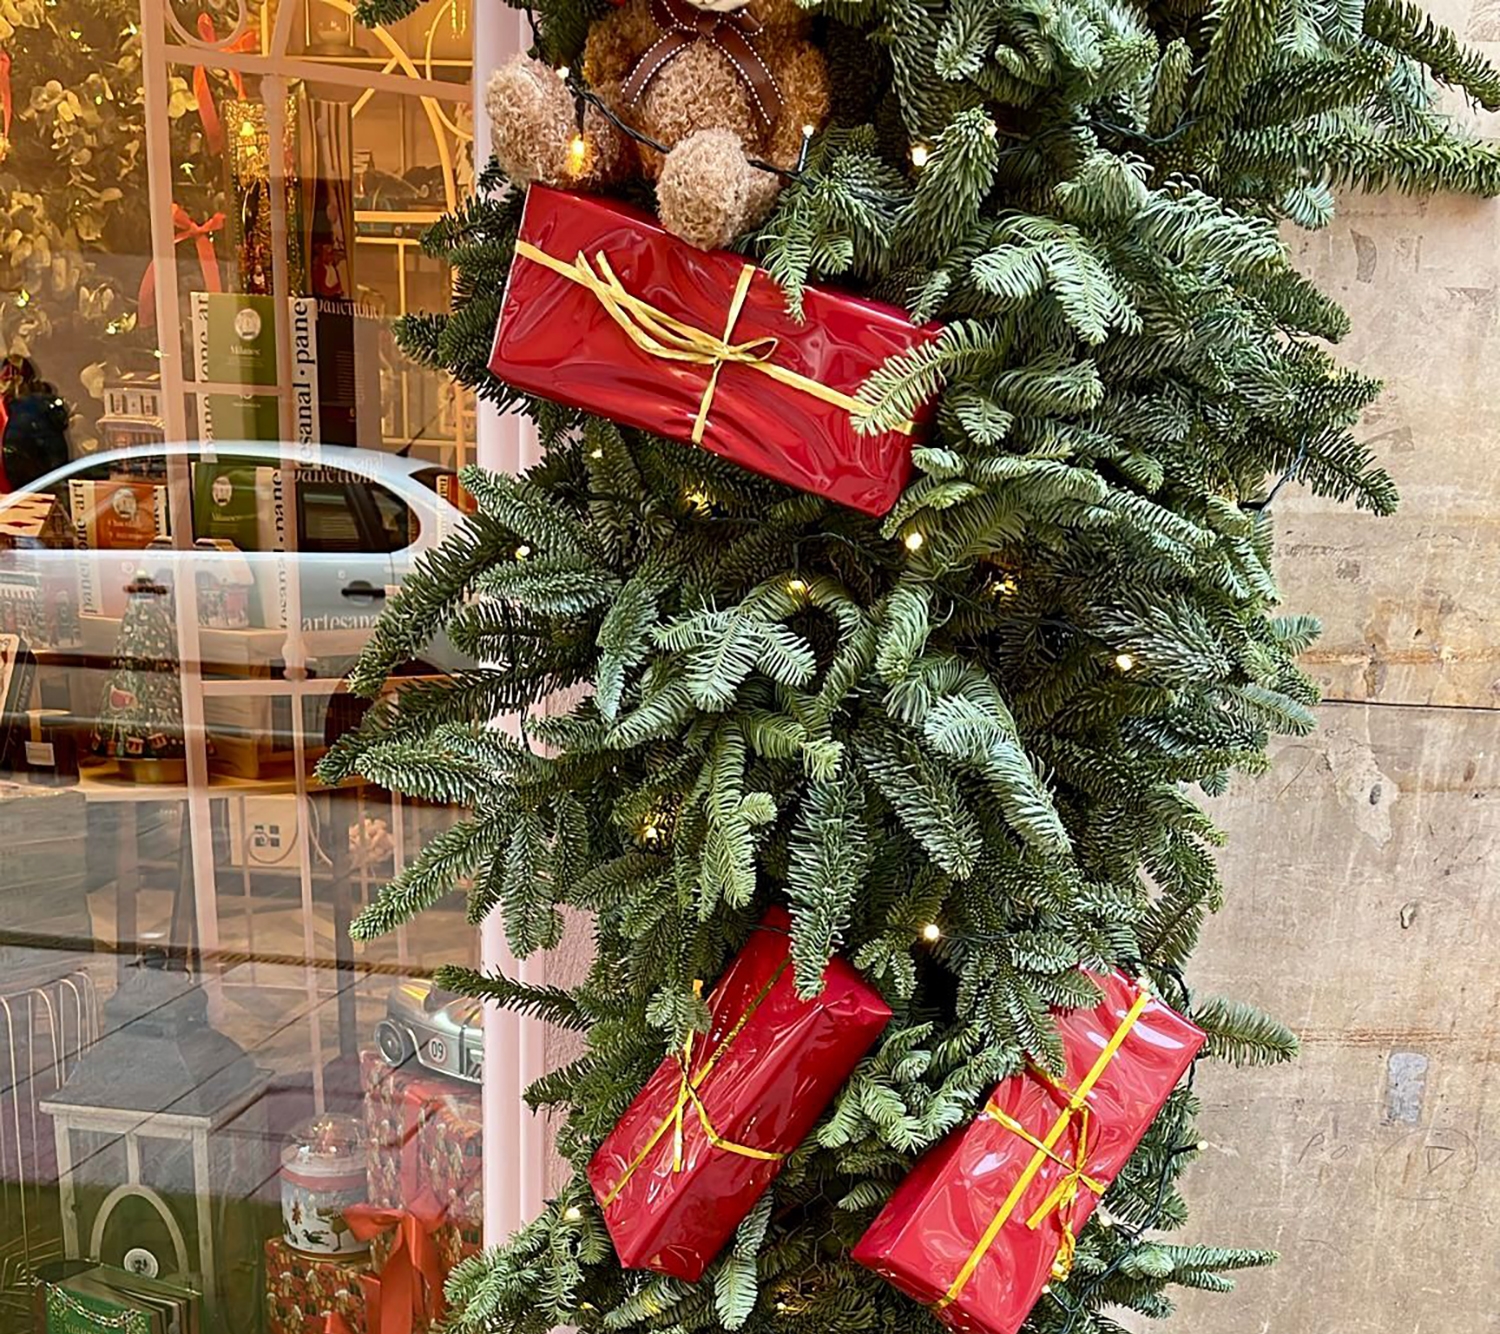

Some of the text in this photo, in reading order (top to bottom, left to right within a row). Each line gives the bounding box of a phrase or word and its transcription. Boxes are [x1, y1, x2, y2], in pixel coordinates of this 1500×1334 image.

[293, 300, 315, 365] pane
[302, 613, 379, 631] artesana
[431, 1040, 444, 1060] 09
